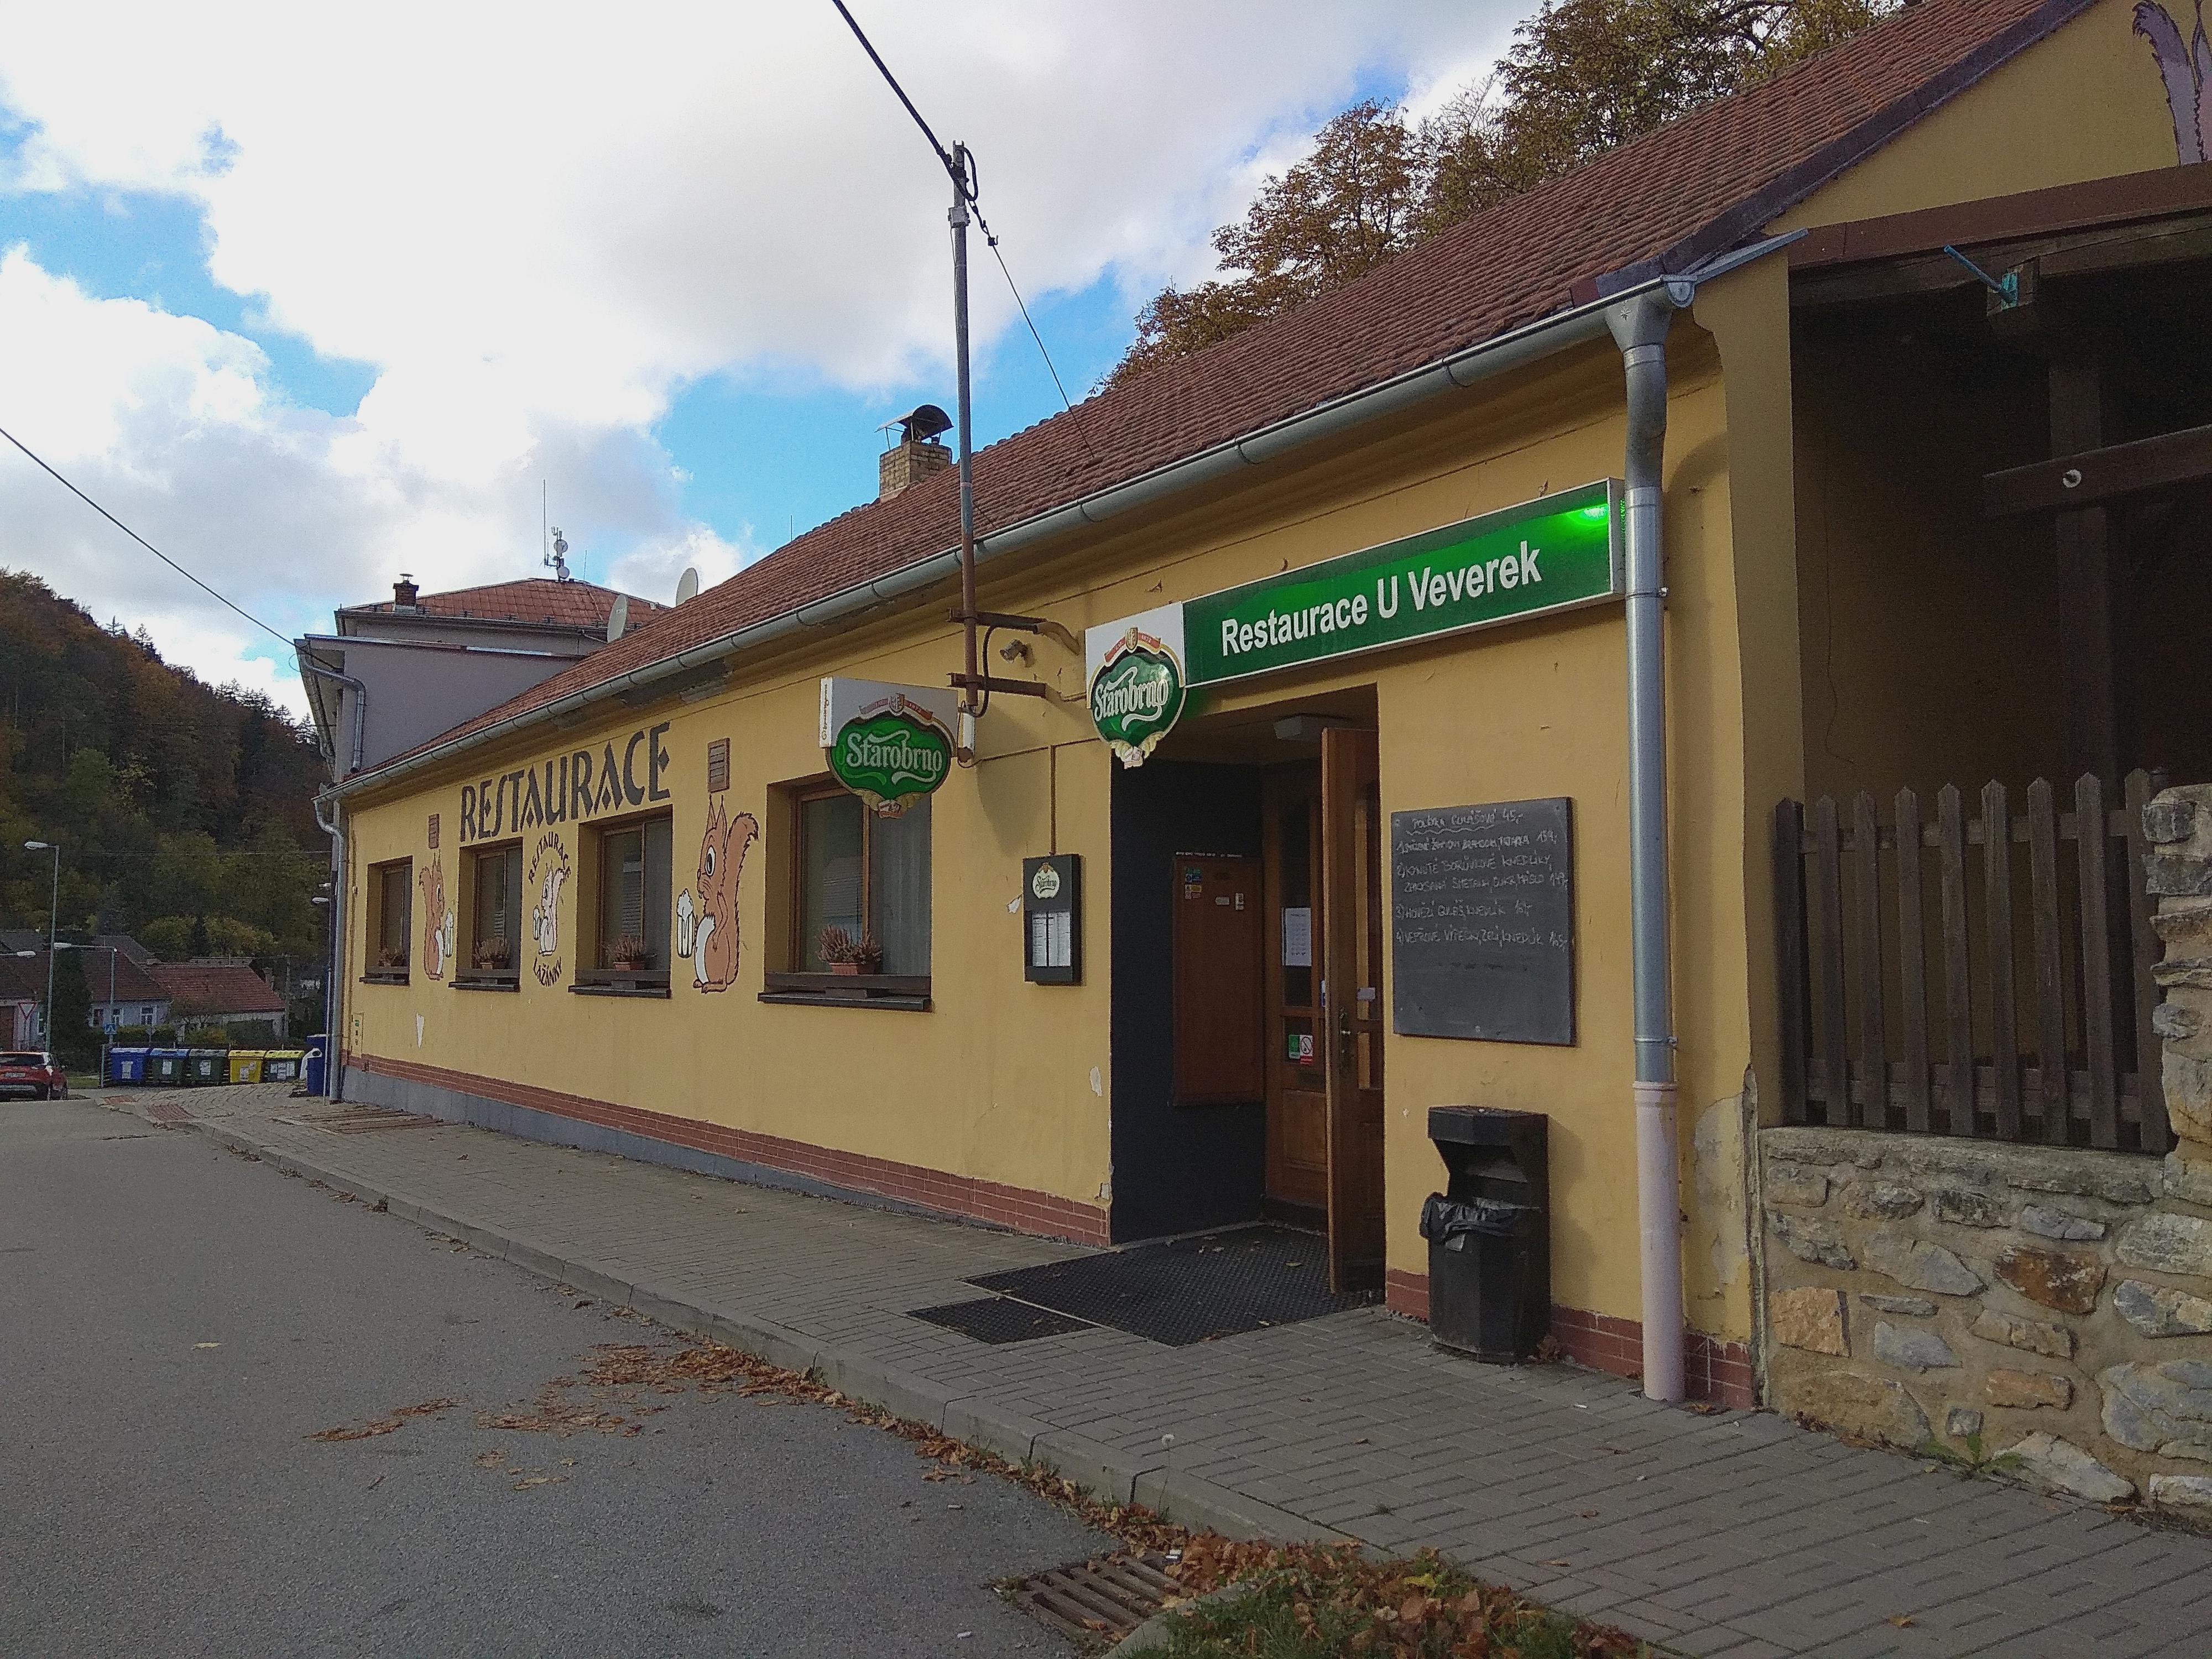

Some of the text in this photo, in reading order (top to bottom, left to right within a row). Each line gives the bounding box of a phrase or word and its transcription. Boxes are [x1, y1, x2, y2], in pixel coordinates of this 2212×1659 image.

[1222, 540, 1542, 656] Restaurace U Veverek
[1094, 666, 1168, 731] Starobrno
[460, 722, 670, 842] RESTAURACE
[846, 729, 942, 785] Starobrno
[528, 831, 572, 885] RESTAURACE
[533, 956, 562, 987] LAŽÁNKY
